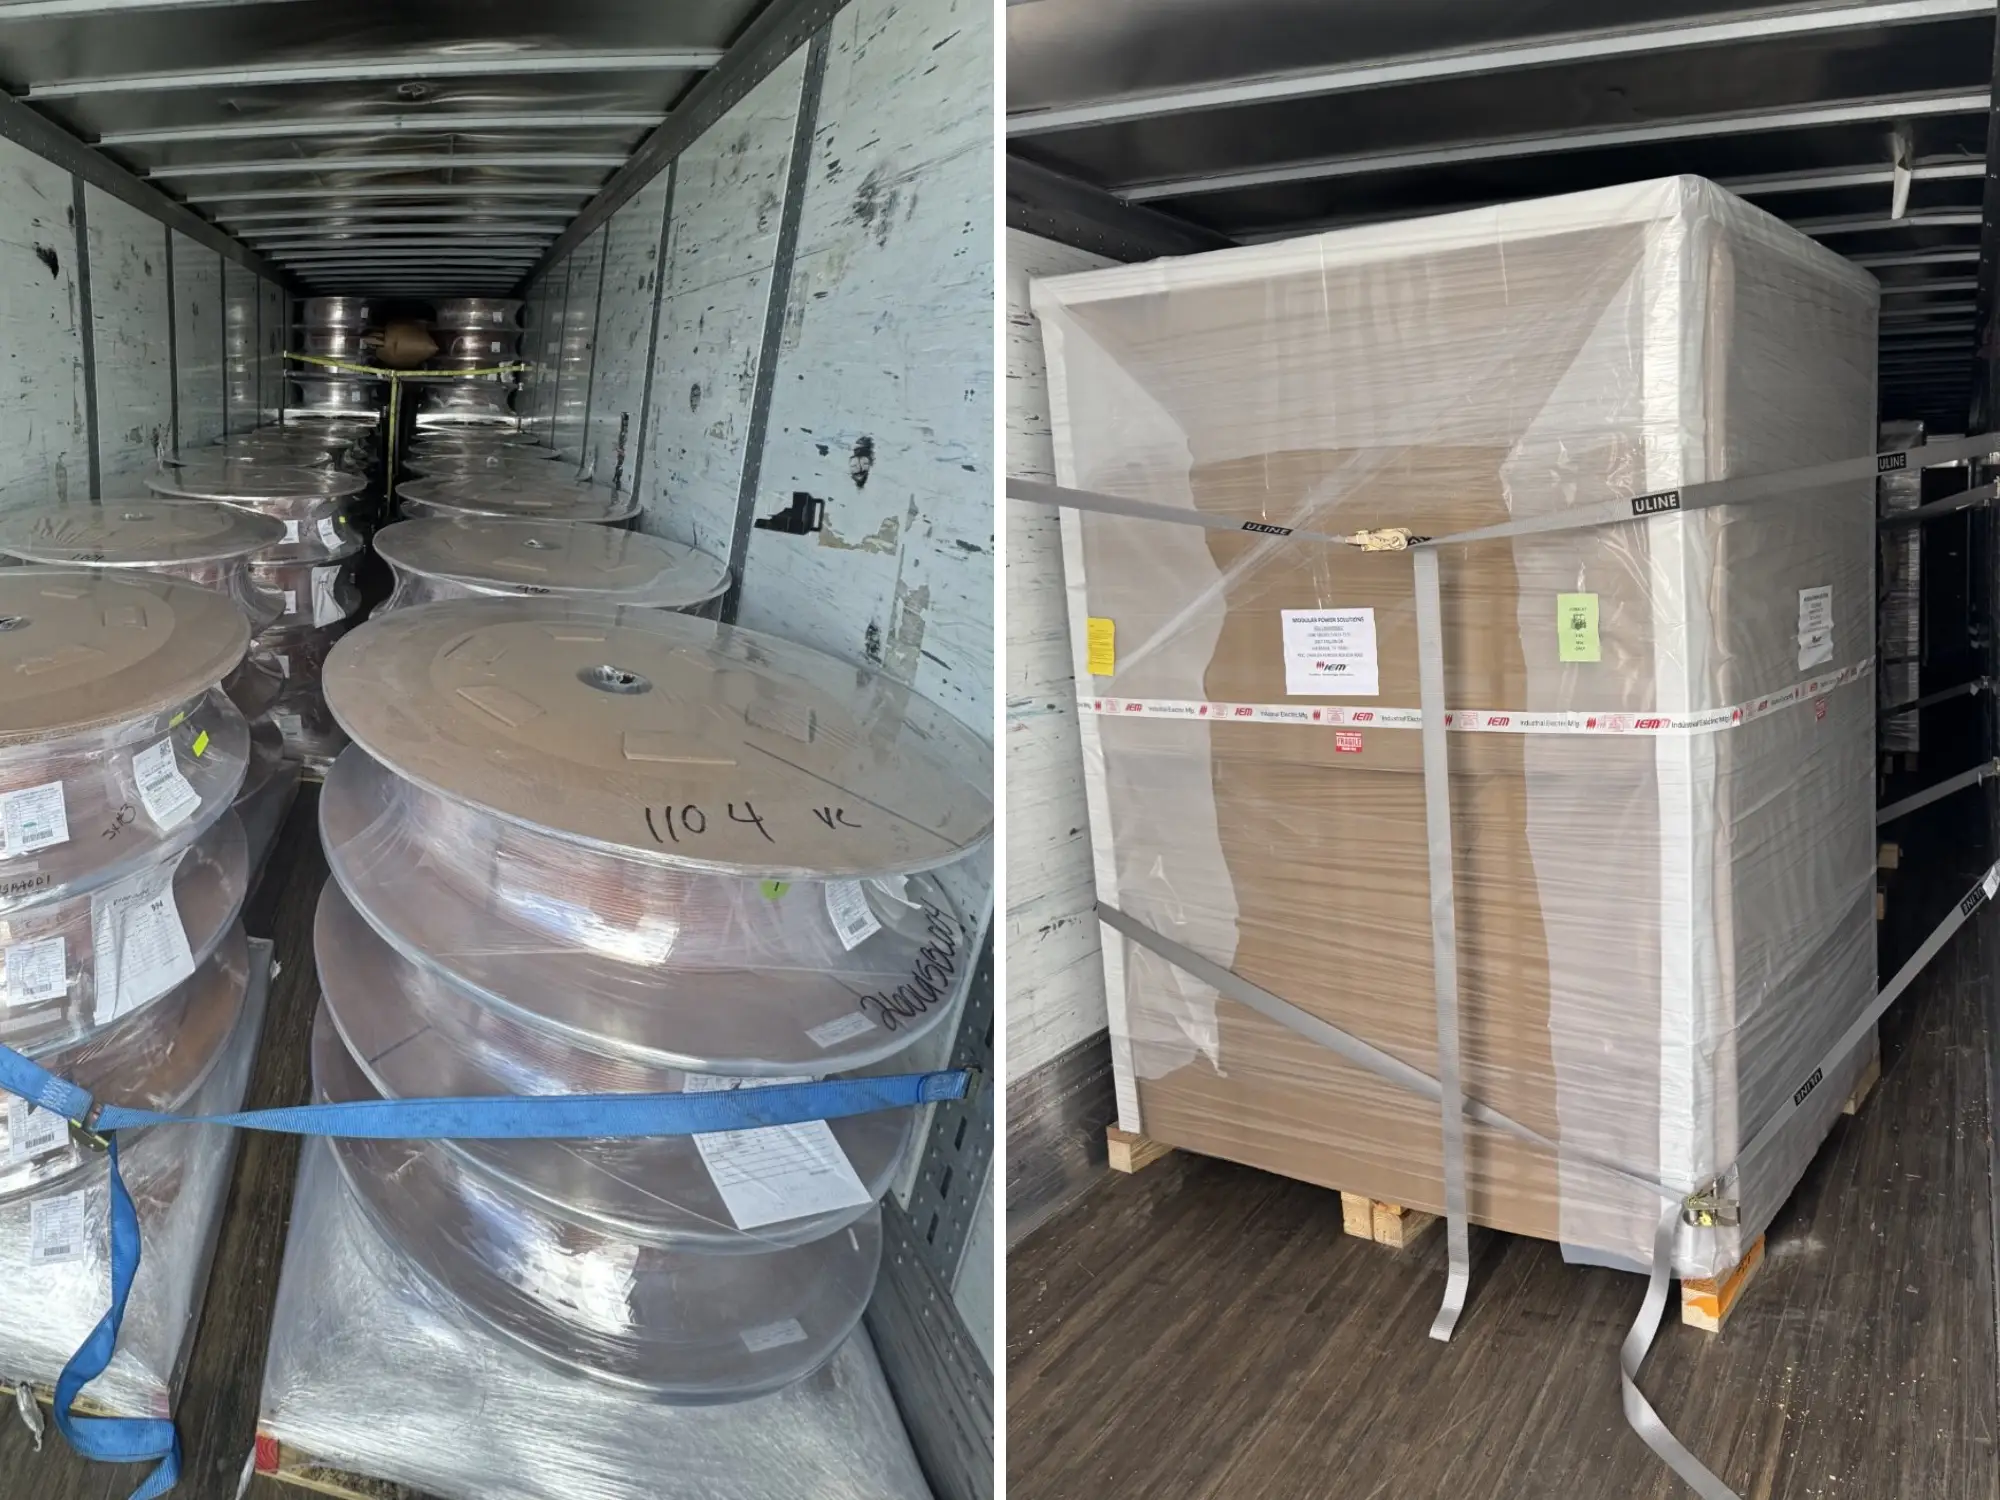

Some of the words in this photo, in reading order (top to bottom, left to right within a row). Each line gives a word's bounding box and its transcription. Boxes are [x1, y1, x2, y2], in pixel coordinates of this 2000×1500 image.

[1878, 454, 1905, 470] ULINE
[1634, 493, 1677, 513] ULINE
[1245, 522, 1290, 536] ULINE
[1337, 615, 1365, 623] SOLUTIONS
[1125, 703, 1143, 712] IEM
[1235, 706, 1252, 716] IEM
[1352, 712, 1374, 721] IEM
[1487, 717, 1510, 726] IEM
[1795, 1069, 1822, 1105] ULINE
